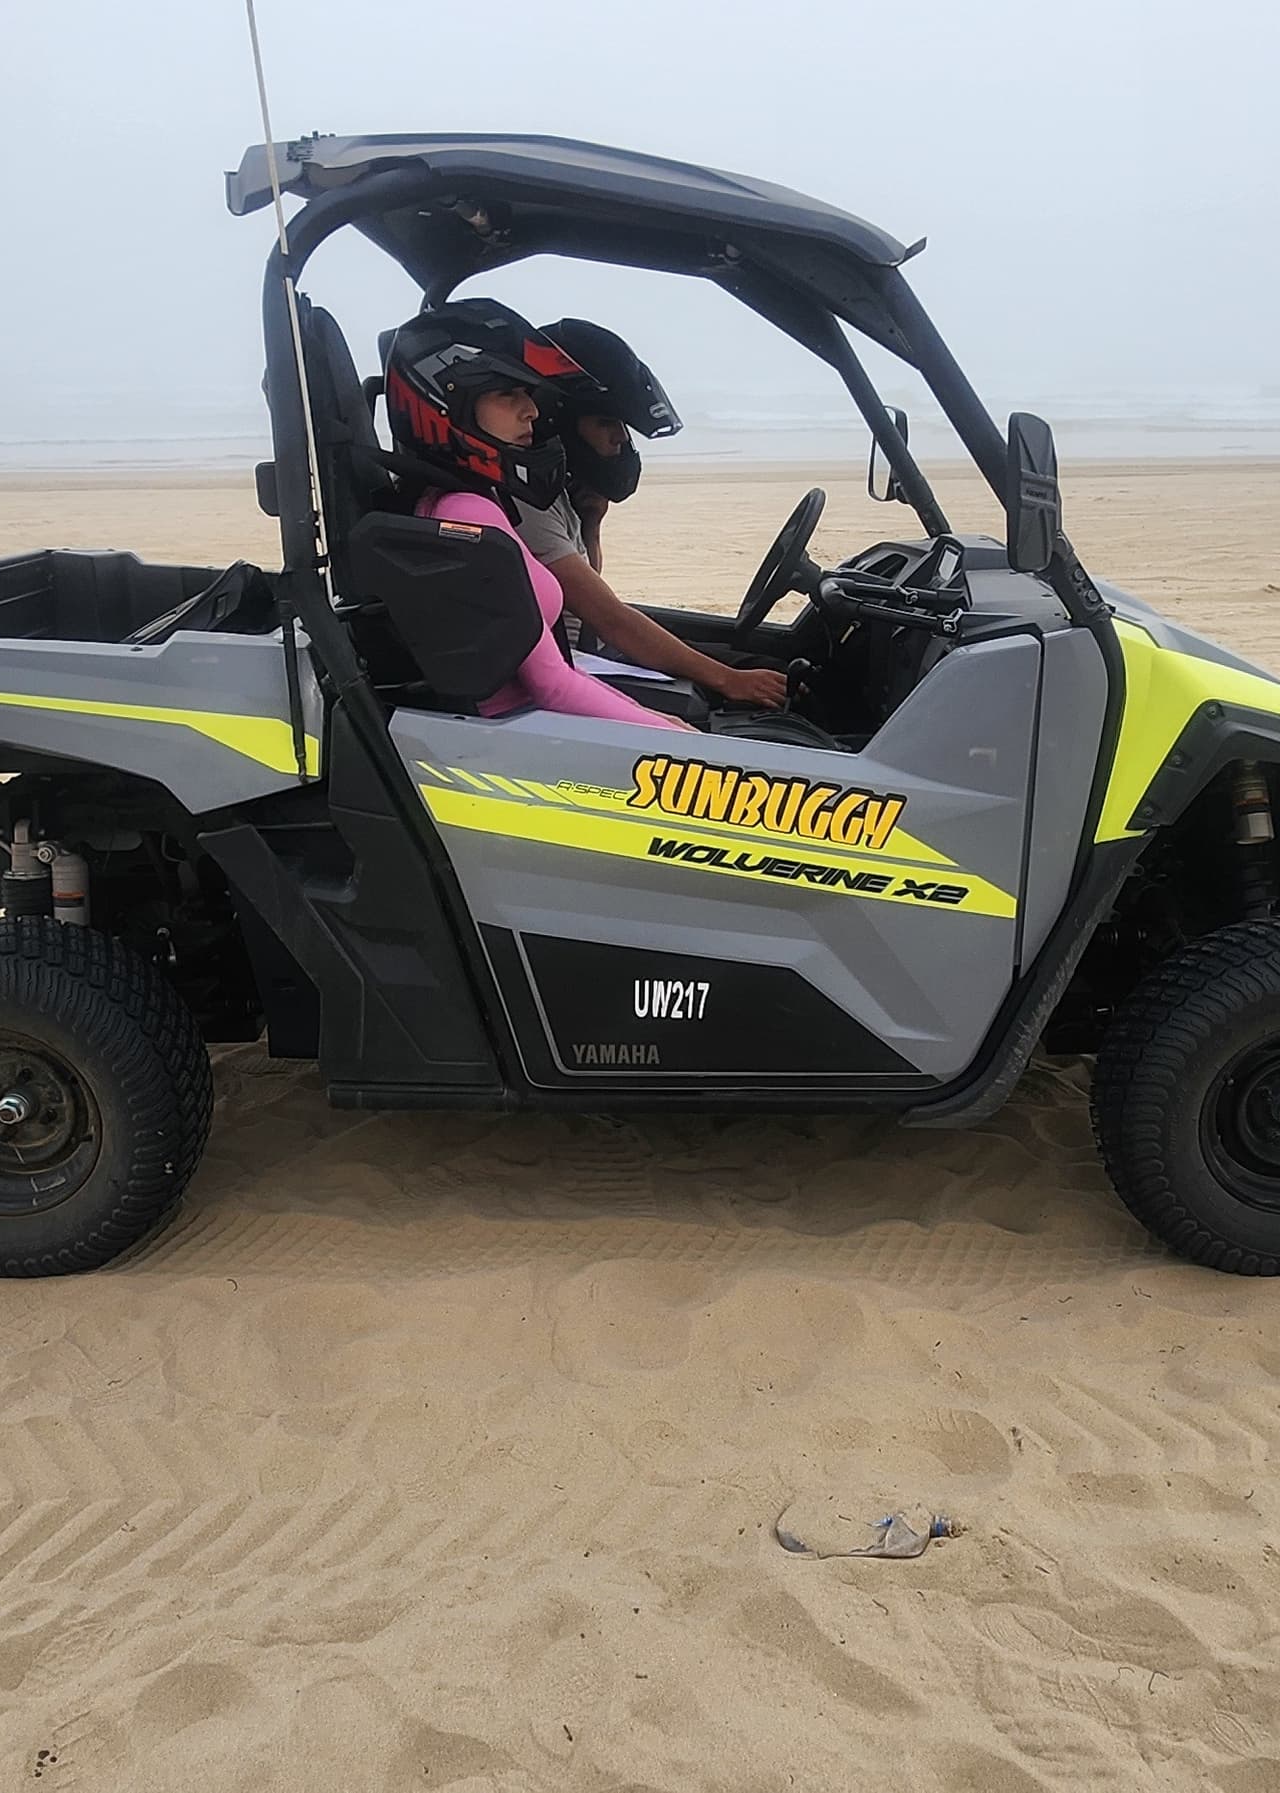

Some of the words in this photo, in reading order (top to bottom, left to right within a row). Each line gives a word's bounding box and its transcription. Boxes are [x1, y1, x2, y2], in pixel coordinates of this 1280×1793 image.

[628, 754, 907, 849] SUNBUGGY
[647, 837, 895, 894] WOLVERINE
[892, 879, 970, 905] X2
[634, 979, 710, 1019] UW217
[572, 1044, 660, 1064] YAMAHA
